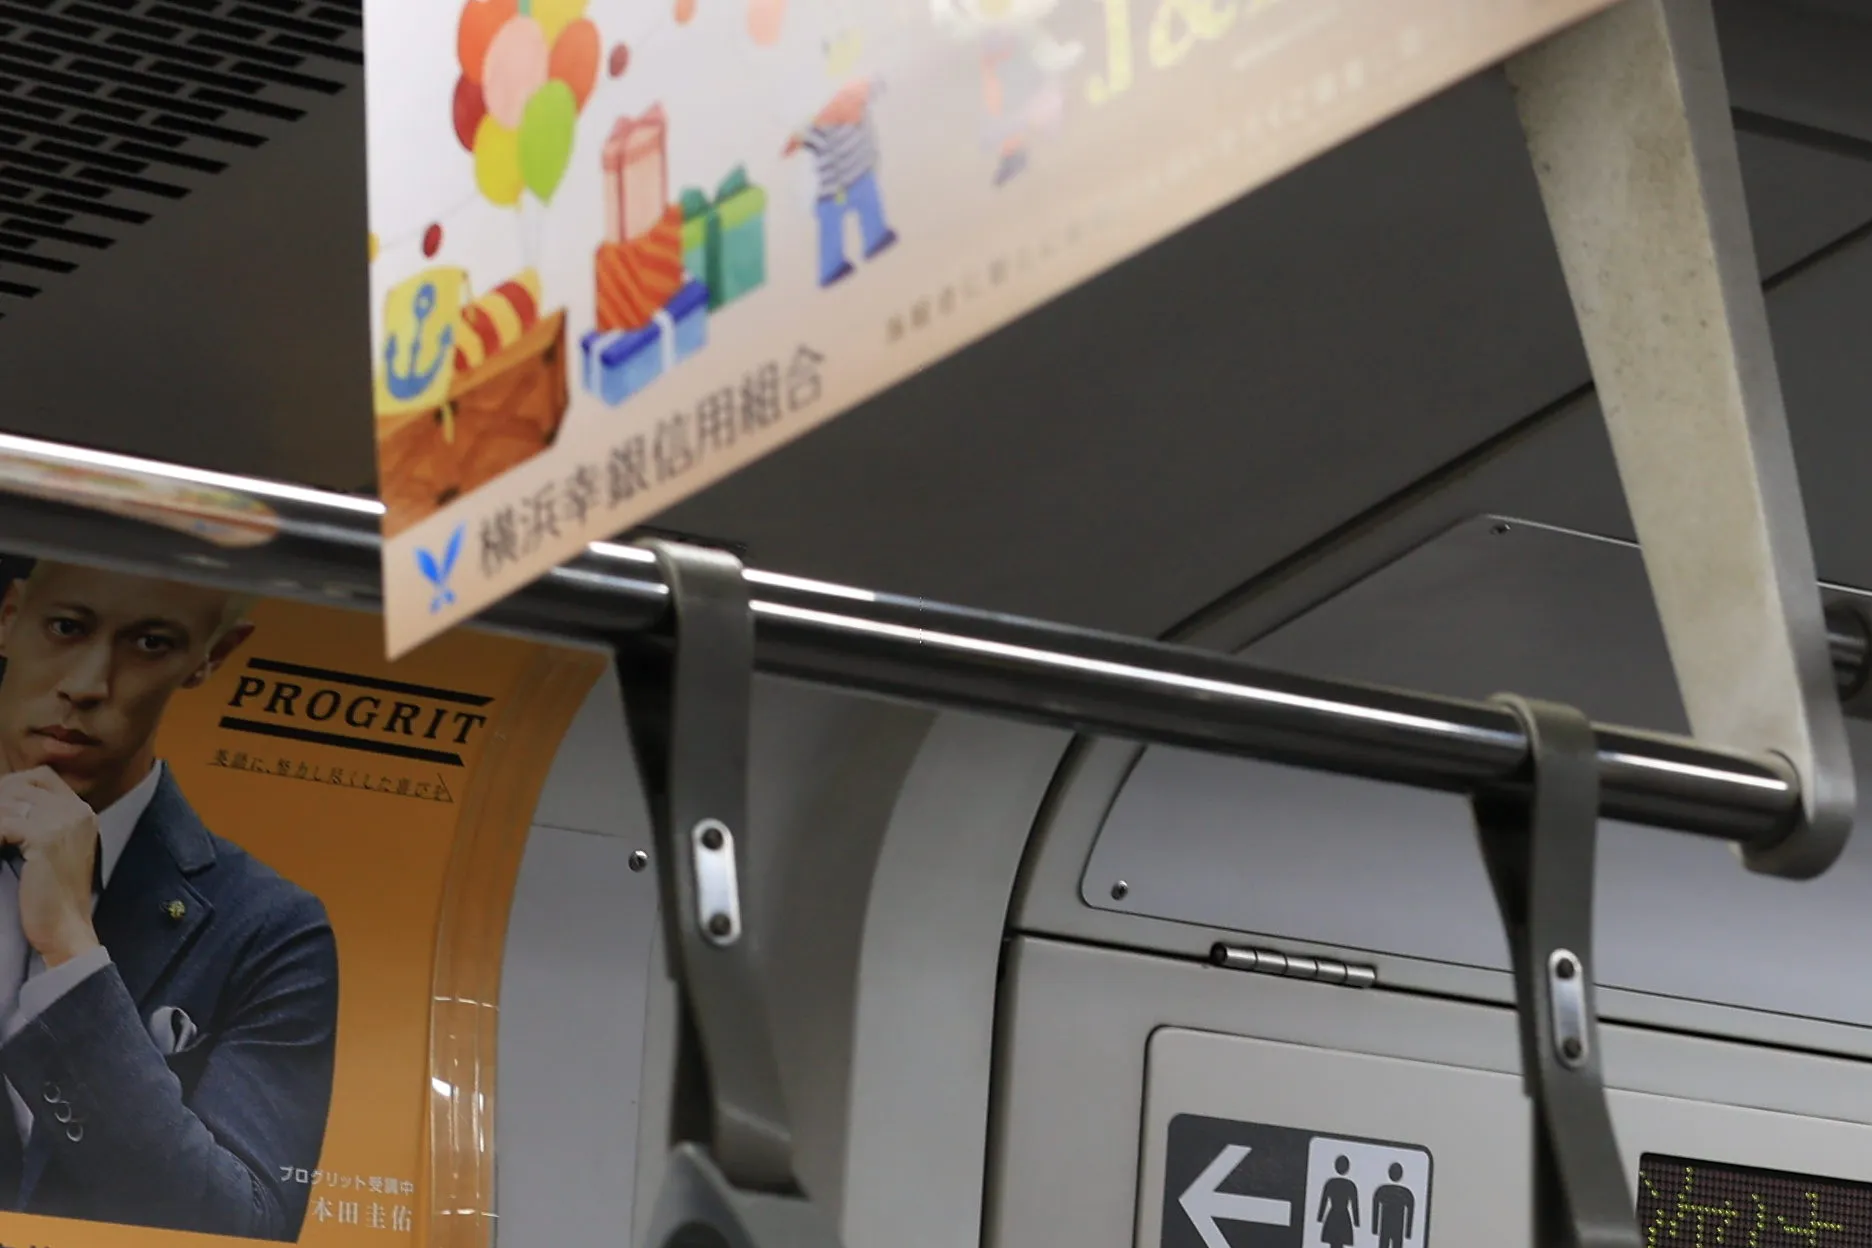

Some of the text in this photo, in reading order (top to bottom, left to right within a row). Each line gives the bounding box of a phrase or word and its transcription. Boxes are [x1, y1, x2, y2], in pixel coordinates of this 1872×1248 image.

[480, 343, 828, 577] 横浜幸銀信用組合
[228, 675, 487, 745] PROGRIT
[280, 1165, 414, 1196] プログリット受講中
[312, 1196, 413, 1232] 本田圭佑
